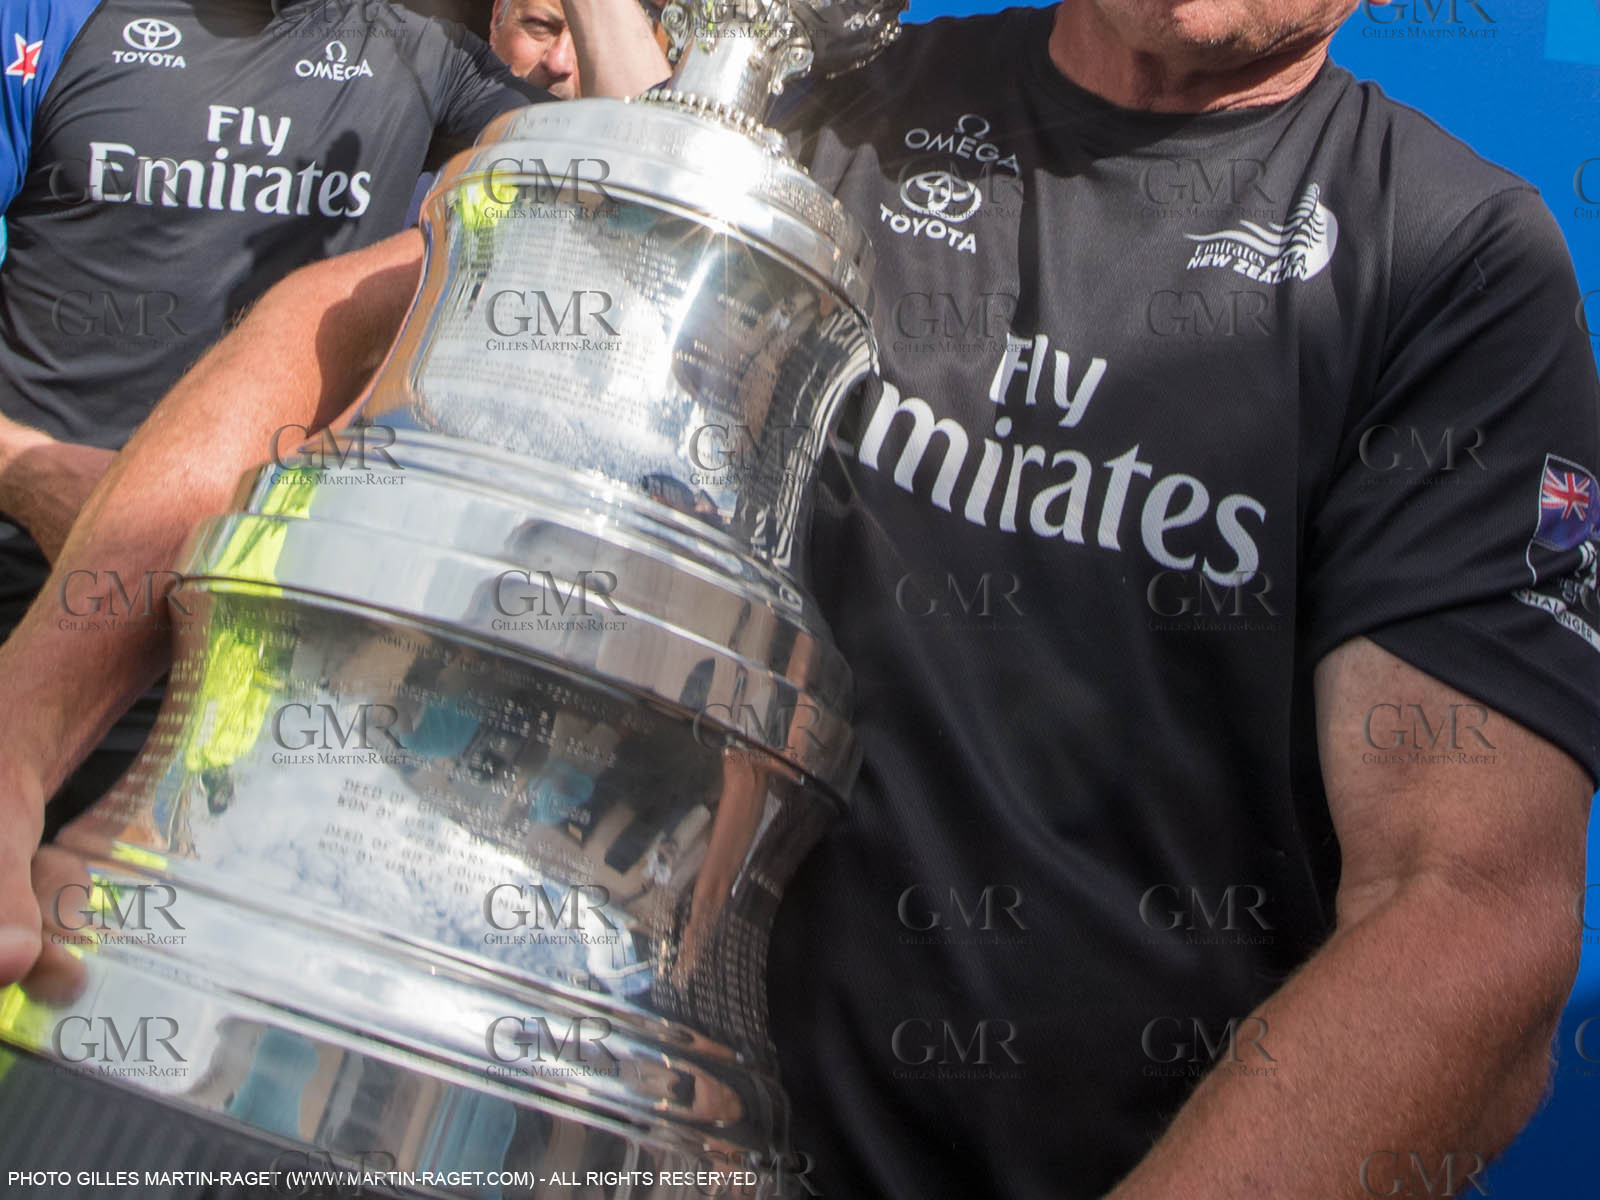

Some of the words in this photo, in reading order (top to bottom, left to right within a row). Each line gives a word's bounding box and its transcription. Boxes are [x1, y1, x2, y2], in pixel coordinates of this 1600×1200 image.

[112, 50, 186, 68] TOYOTA
[294, 58, 374, 81] OMEGA
[206, 104, 291, 156] Fly
[904, 127, 1021, 175] OMEGA
[89, 141, 372, 217] Emirates
[879, 202, 977, 254] TOYOTA
[1186, 253, 1232, 270] NEW
[989, 332, 1108, 428] Fly
[857, 380, 1267, 587] mirates
